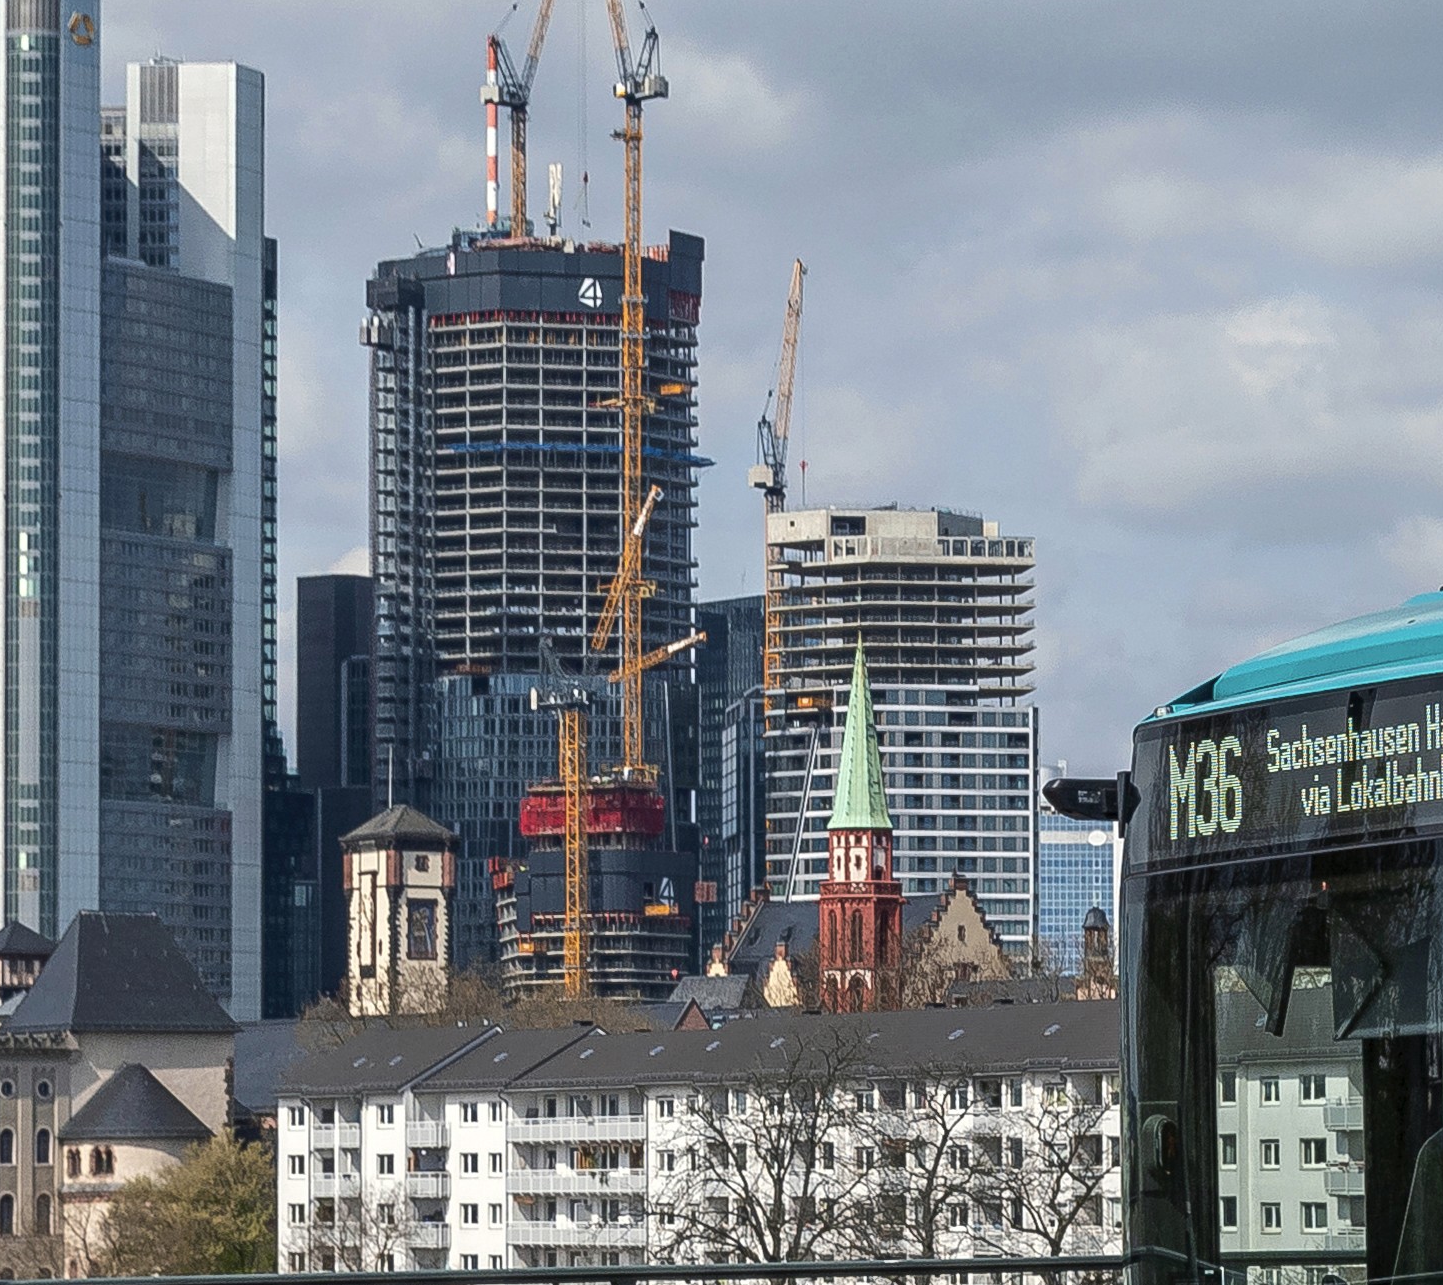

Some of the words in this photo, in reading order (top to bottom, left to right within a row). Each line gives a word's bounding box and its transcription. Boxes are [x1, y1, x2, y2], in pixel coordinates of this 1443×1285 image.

[1266, 717, 1420, 773] Sachsenhausen
[1169, 735, 1244, 840] M36
[1301, 774, 1331, 817] via
